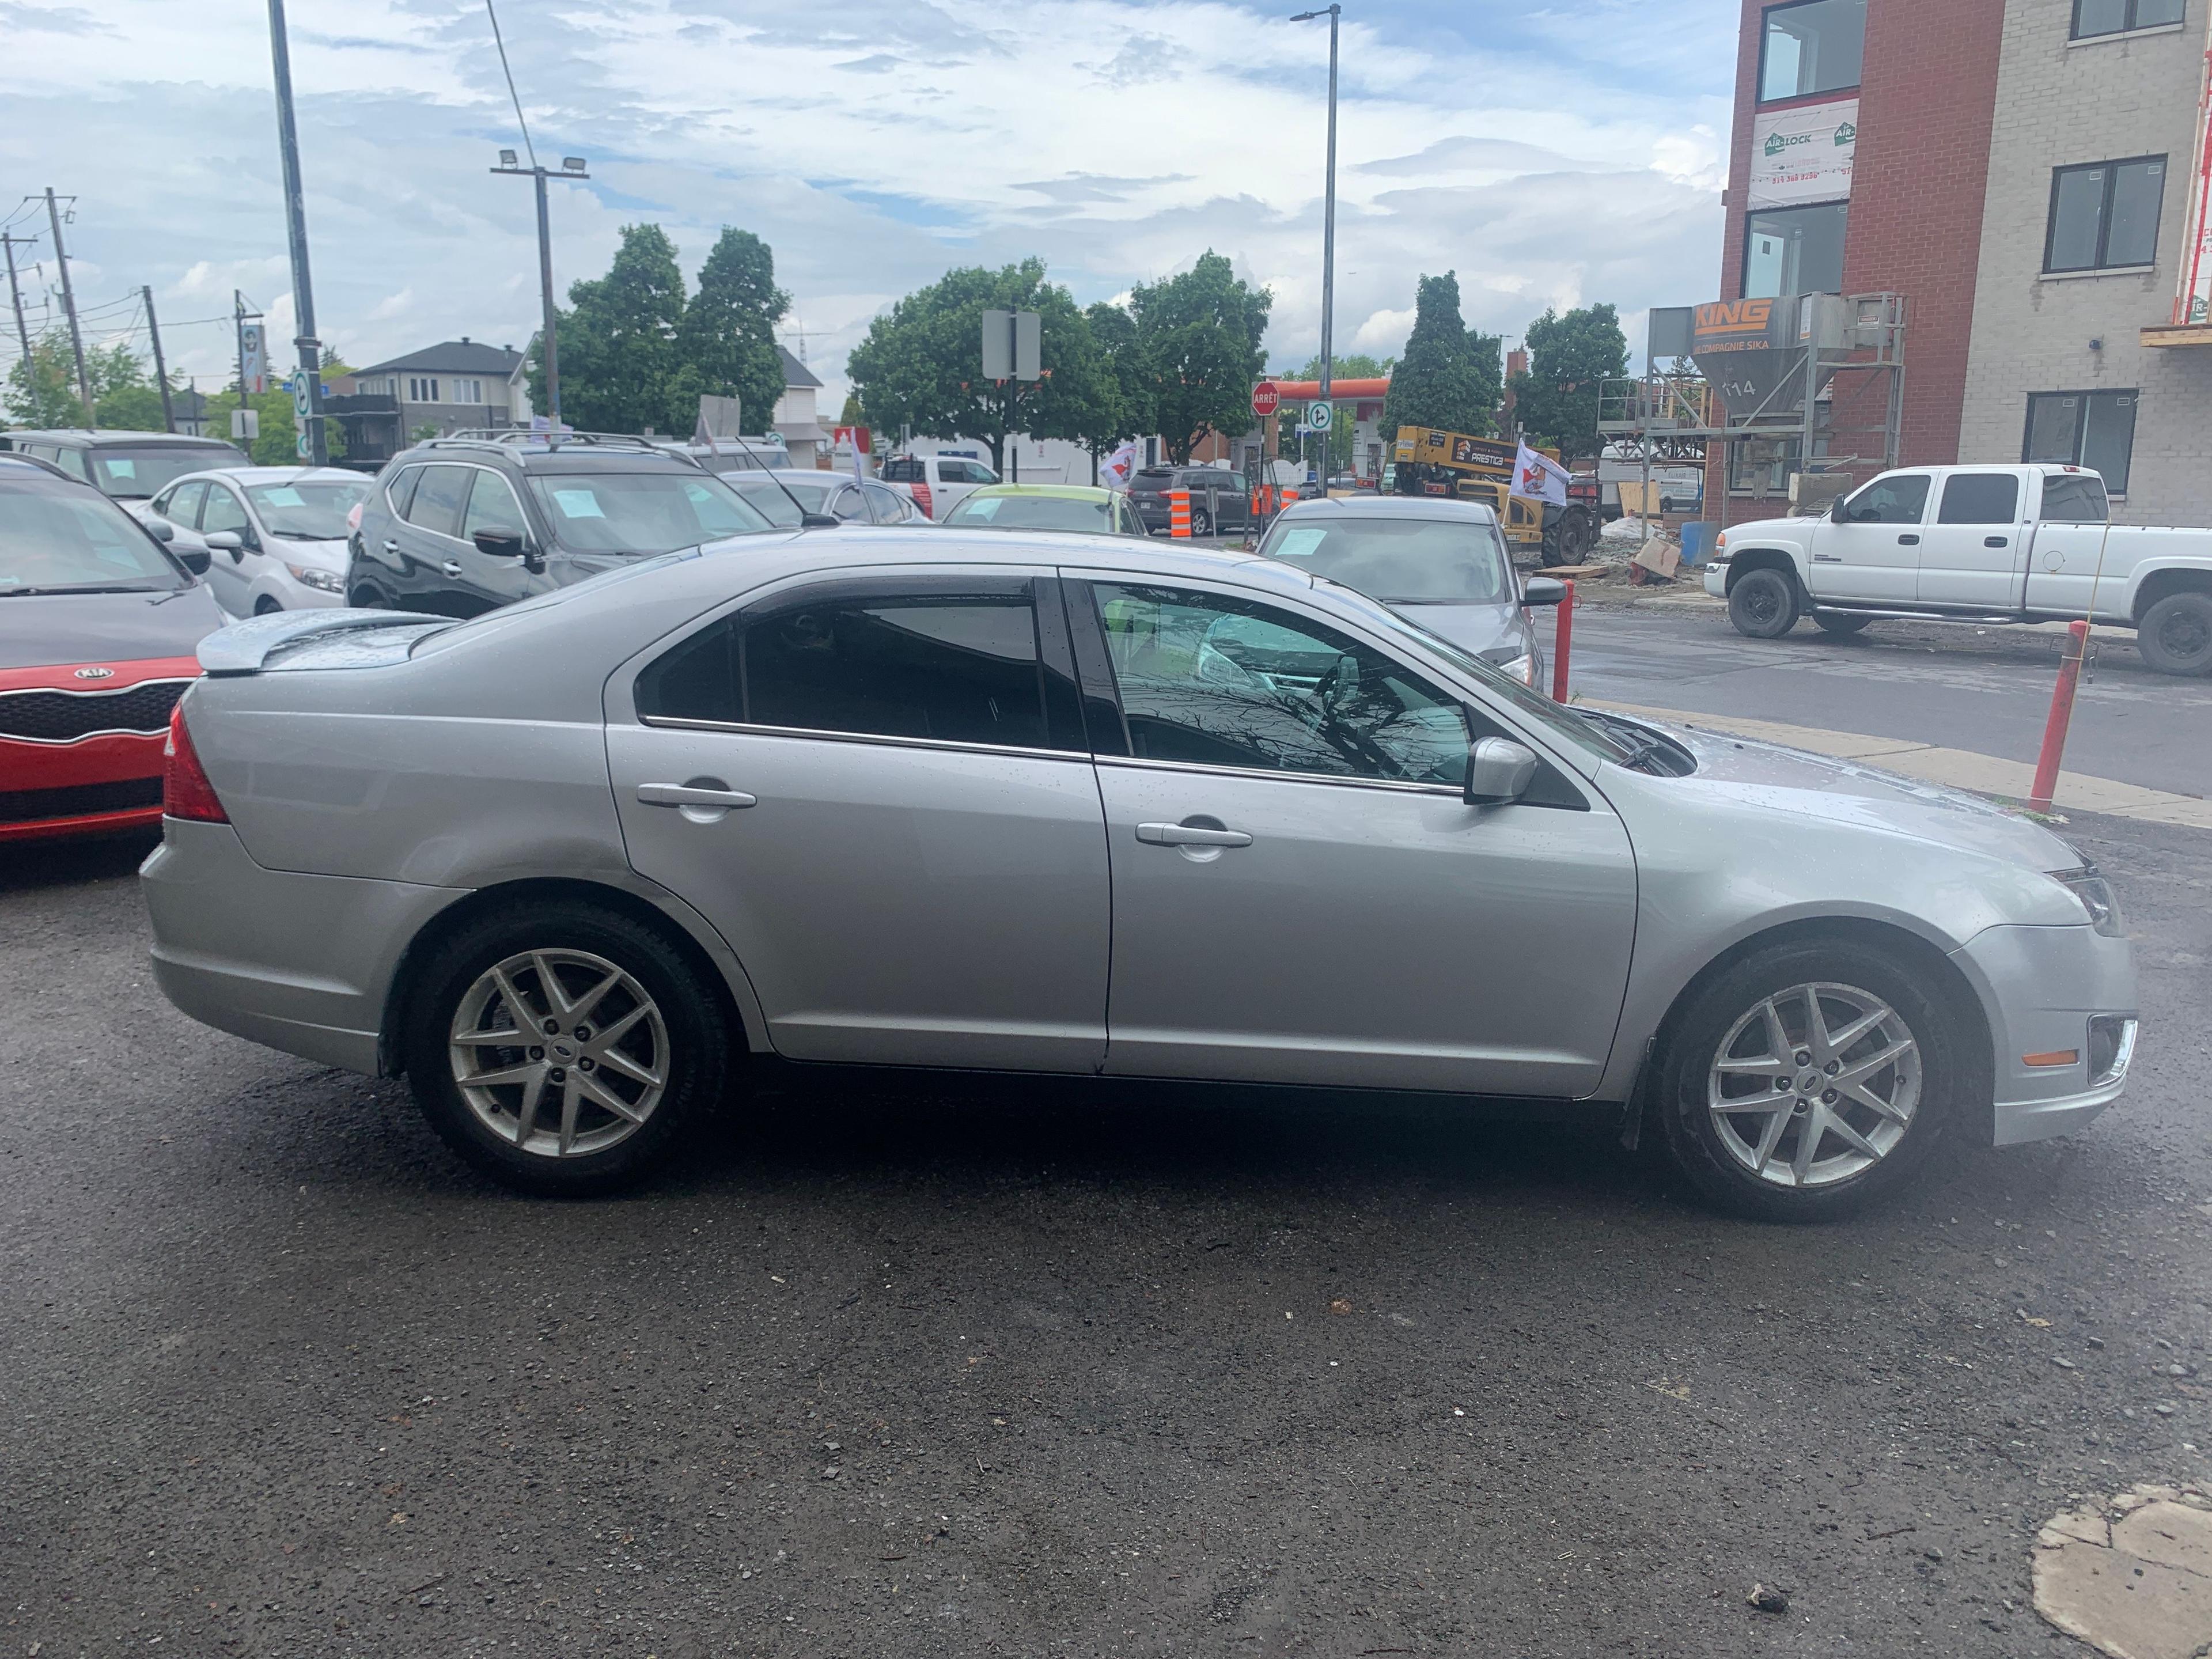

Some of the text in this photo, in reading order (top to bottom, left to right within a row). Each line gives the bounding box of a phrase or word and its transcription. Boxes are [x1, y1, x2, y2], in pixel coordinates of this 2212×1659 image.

[1836, 128, 1855, 137] AIR-
[1695, 299, 1772, 327] KING
[1702, 342, 1745, 354] COMPAGNIE
[1747, 340, 1770, 350] SIKA
[1254, 392, 1277, 403] ARRÊT
[81, 668, 110, 677] KIA
